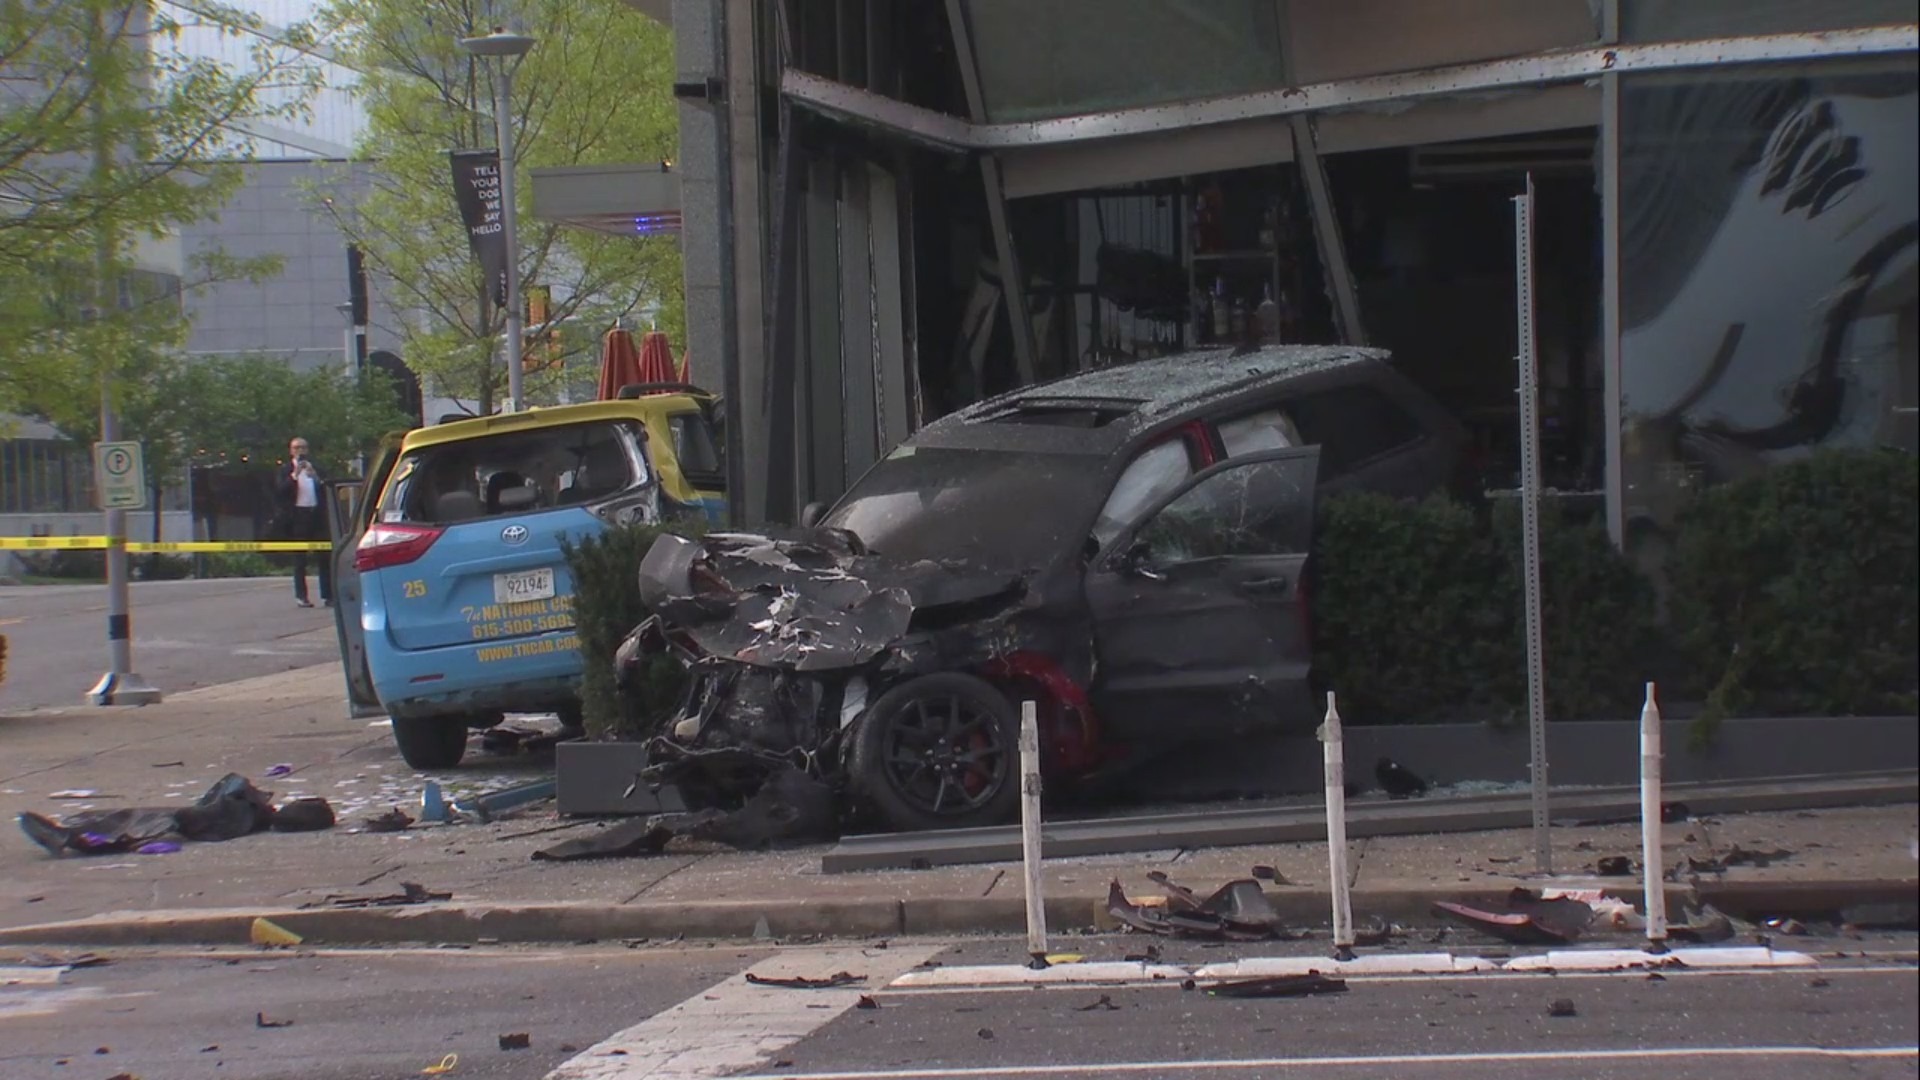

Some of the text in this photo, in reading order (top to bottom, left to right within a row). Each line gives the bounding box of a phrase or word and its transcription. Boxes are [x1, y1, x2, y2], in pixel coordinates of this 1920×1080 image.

[475, 167, 498, 176] TELL
[471, 178, 499, 188] YOUR
[479, 190, 499, 199] DOG
[486, 201, 500, 210] WE
[484, 212, 500, 222] SAY
[472, 223, 501, 235] HELLO
[404, 580, 425, 597] 25
[508, 577, 542, 594] 92194
[483, 600, 547, 620] NATIONAL
